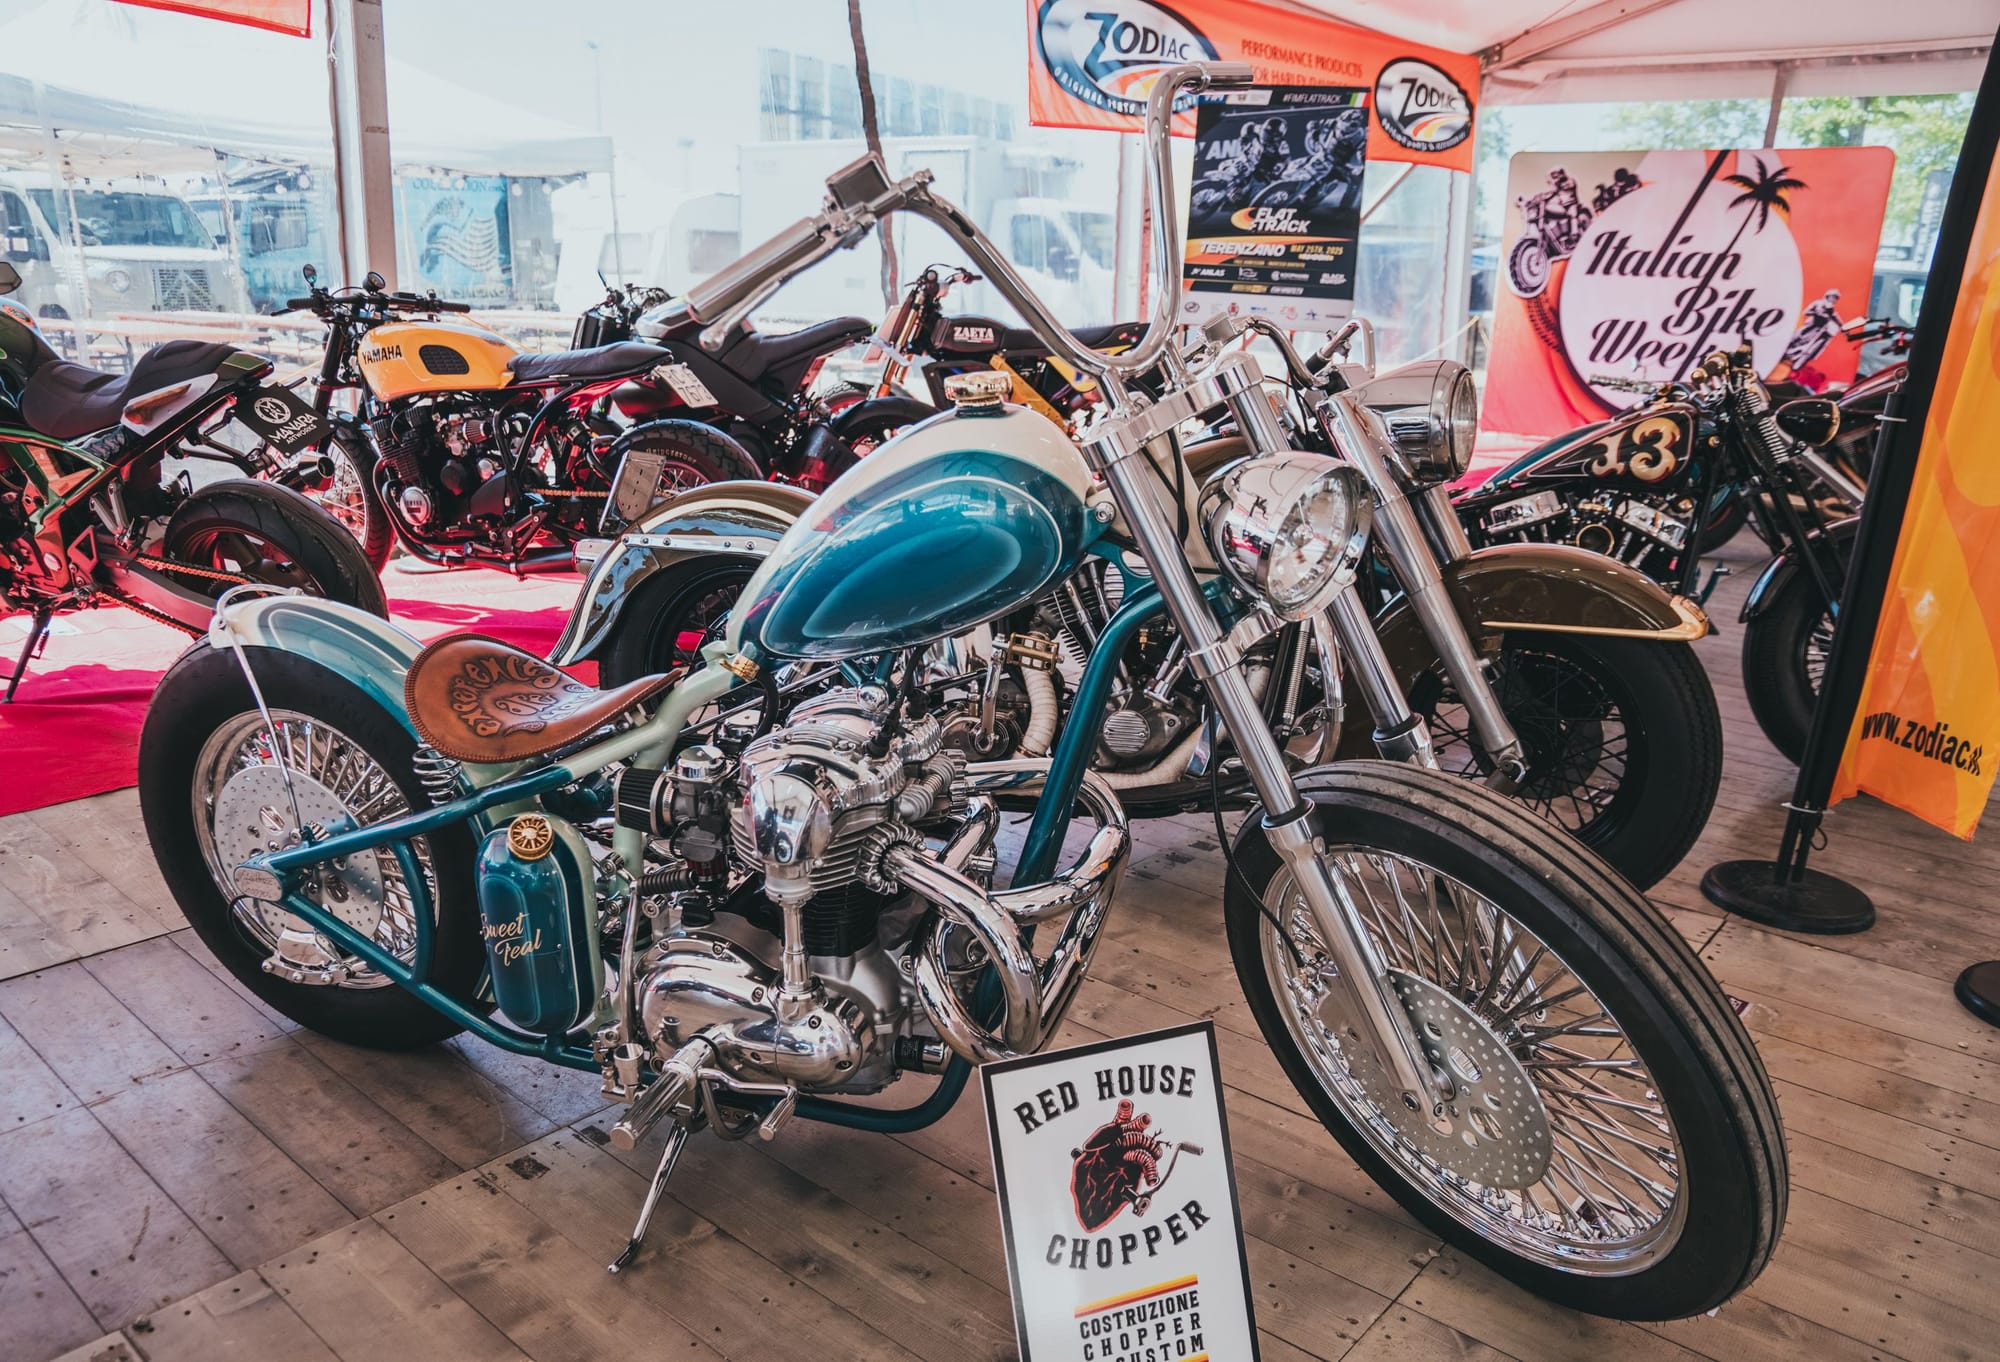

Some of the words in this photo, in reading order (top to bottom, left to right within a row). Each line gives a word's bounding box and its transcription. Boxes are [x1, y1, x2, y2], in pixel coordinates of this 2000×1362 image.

[1084, 12, 1191, 80] ZODIAC
[1241, 40, 1313, 69] PERFORMANCE
[1315, 54, 1363, 78] PRODUCTS
[1053, 66, 1103, 106] ORIGINAL
[1282, 93, 1342, 104] #FIMFLATTRACK
[1254, 207, 1298, 221] FLAT
[1255, 220, 1312, 233] TRACK
[1200, 241, 1286, 257] TERENZANO
[1585, 230, 1742, 280] Italian
[1661, 286, 1785, 337] Bike
[953, 326, 994, 339] ZAETA
[361, 344, 403, 365] YAMAHA
[268, 412, 318, 443] MANARA
[1590, 417, 1681, 482] 13
[479, 912, 531, 941] Sweet
[494, 929, 543, 967] Teal
[1013, 1080, 1080, 1135] RED
[1095, 1064, 1197, 1101] HOUSE
[1046, 1200, 1211, 1270] CHOPPER
[1080, 1290, 1200, 1340] COSTRUZIONE
[1083, 1312, 1202, 1361] CHOPPER
